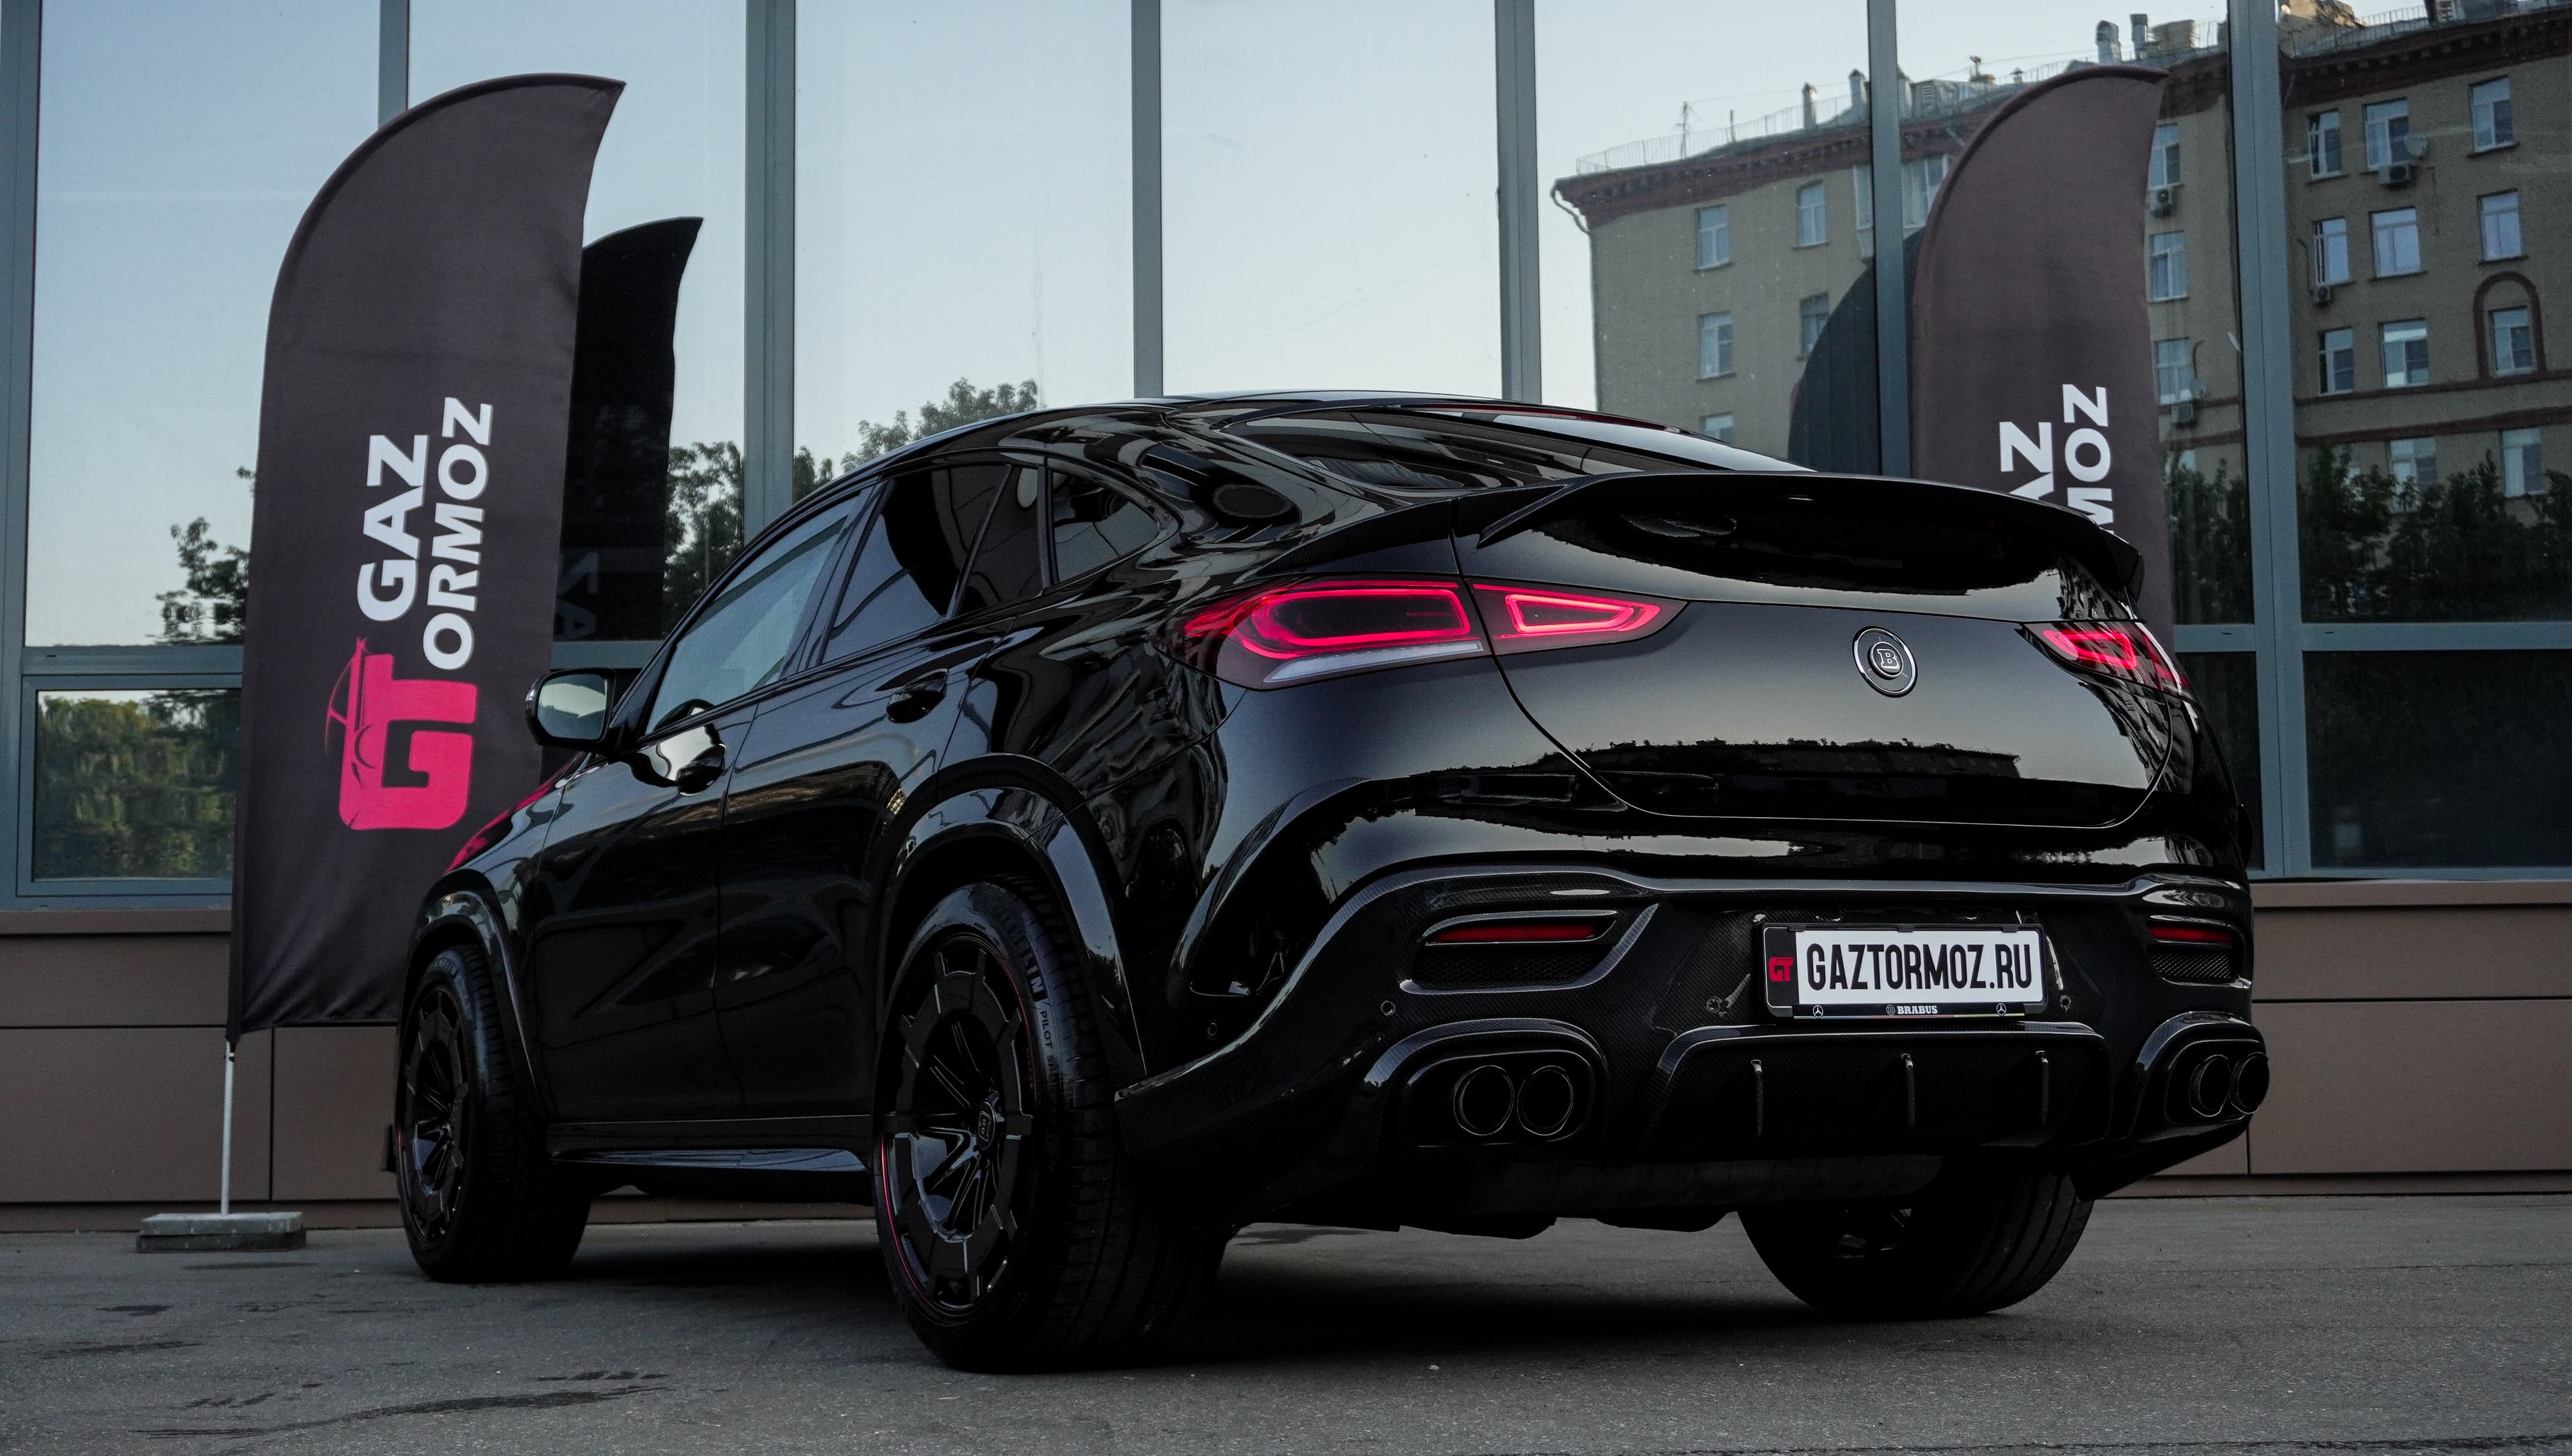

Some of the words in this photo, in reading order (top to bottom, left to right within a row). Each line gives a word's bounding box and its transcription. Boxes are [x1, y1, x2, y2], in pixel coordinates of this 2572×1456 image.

[2063, 384, 2114, 526] MOZ
[357, 435, 428, 622] GAZ
[423, 396, 493, 670] ORMOZ
[337, 652, 478, 830] GT
[1040, 1010, 1052, 1048] PILOT
[1769, 956, 1794, 982] GT
[1806, 943, 2032, 991] GAZTORMOZ.RU
[1896, 1005, 1938, 1015] BRABUS
